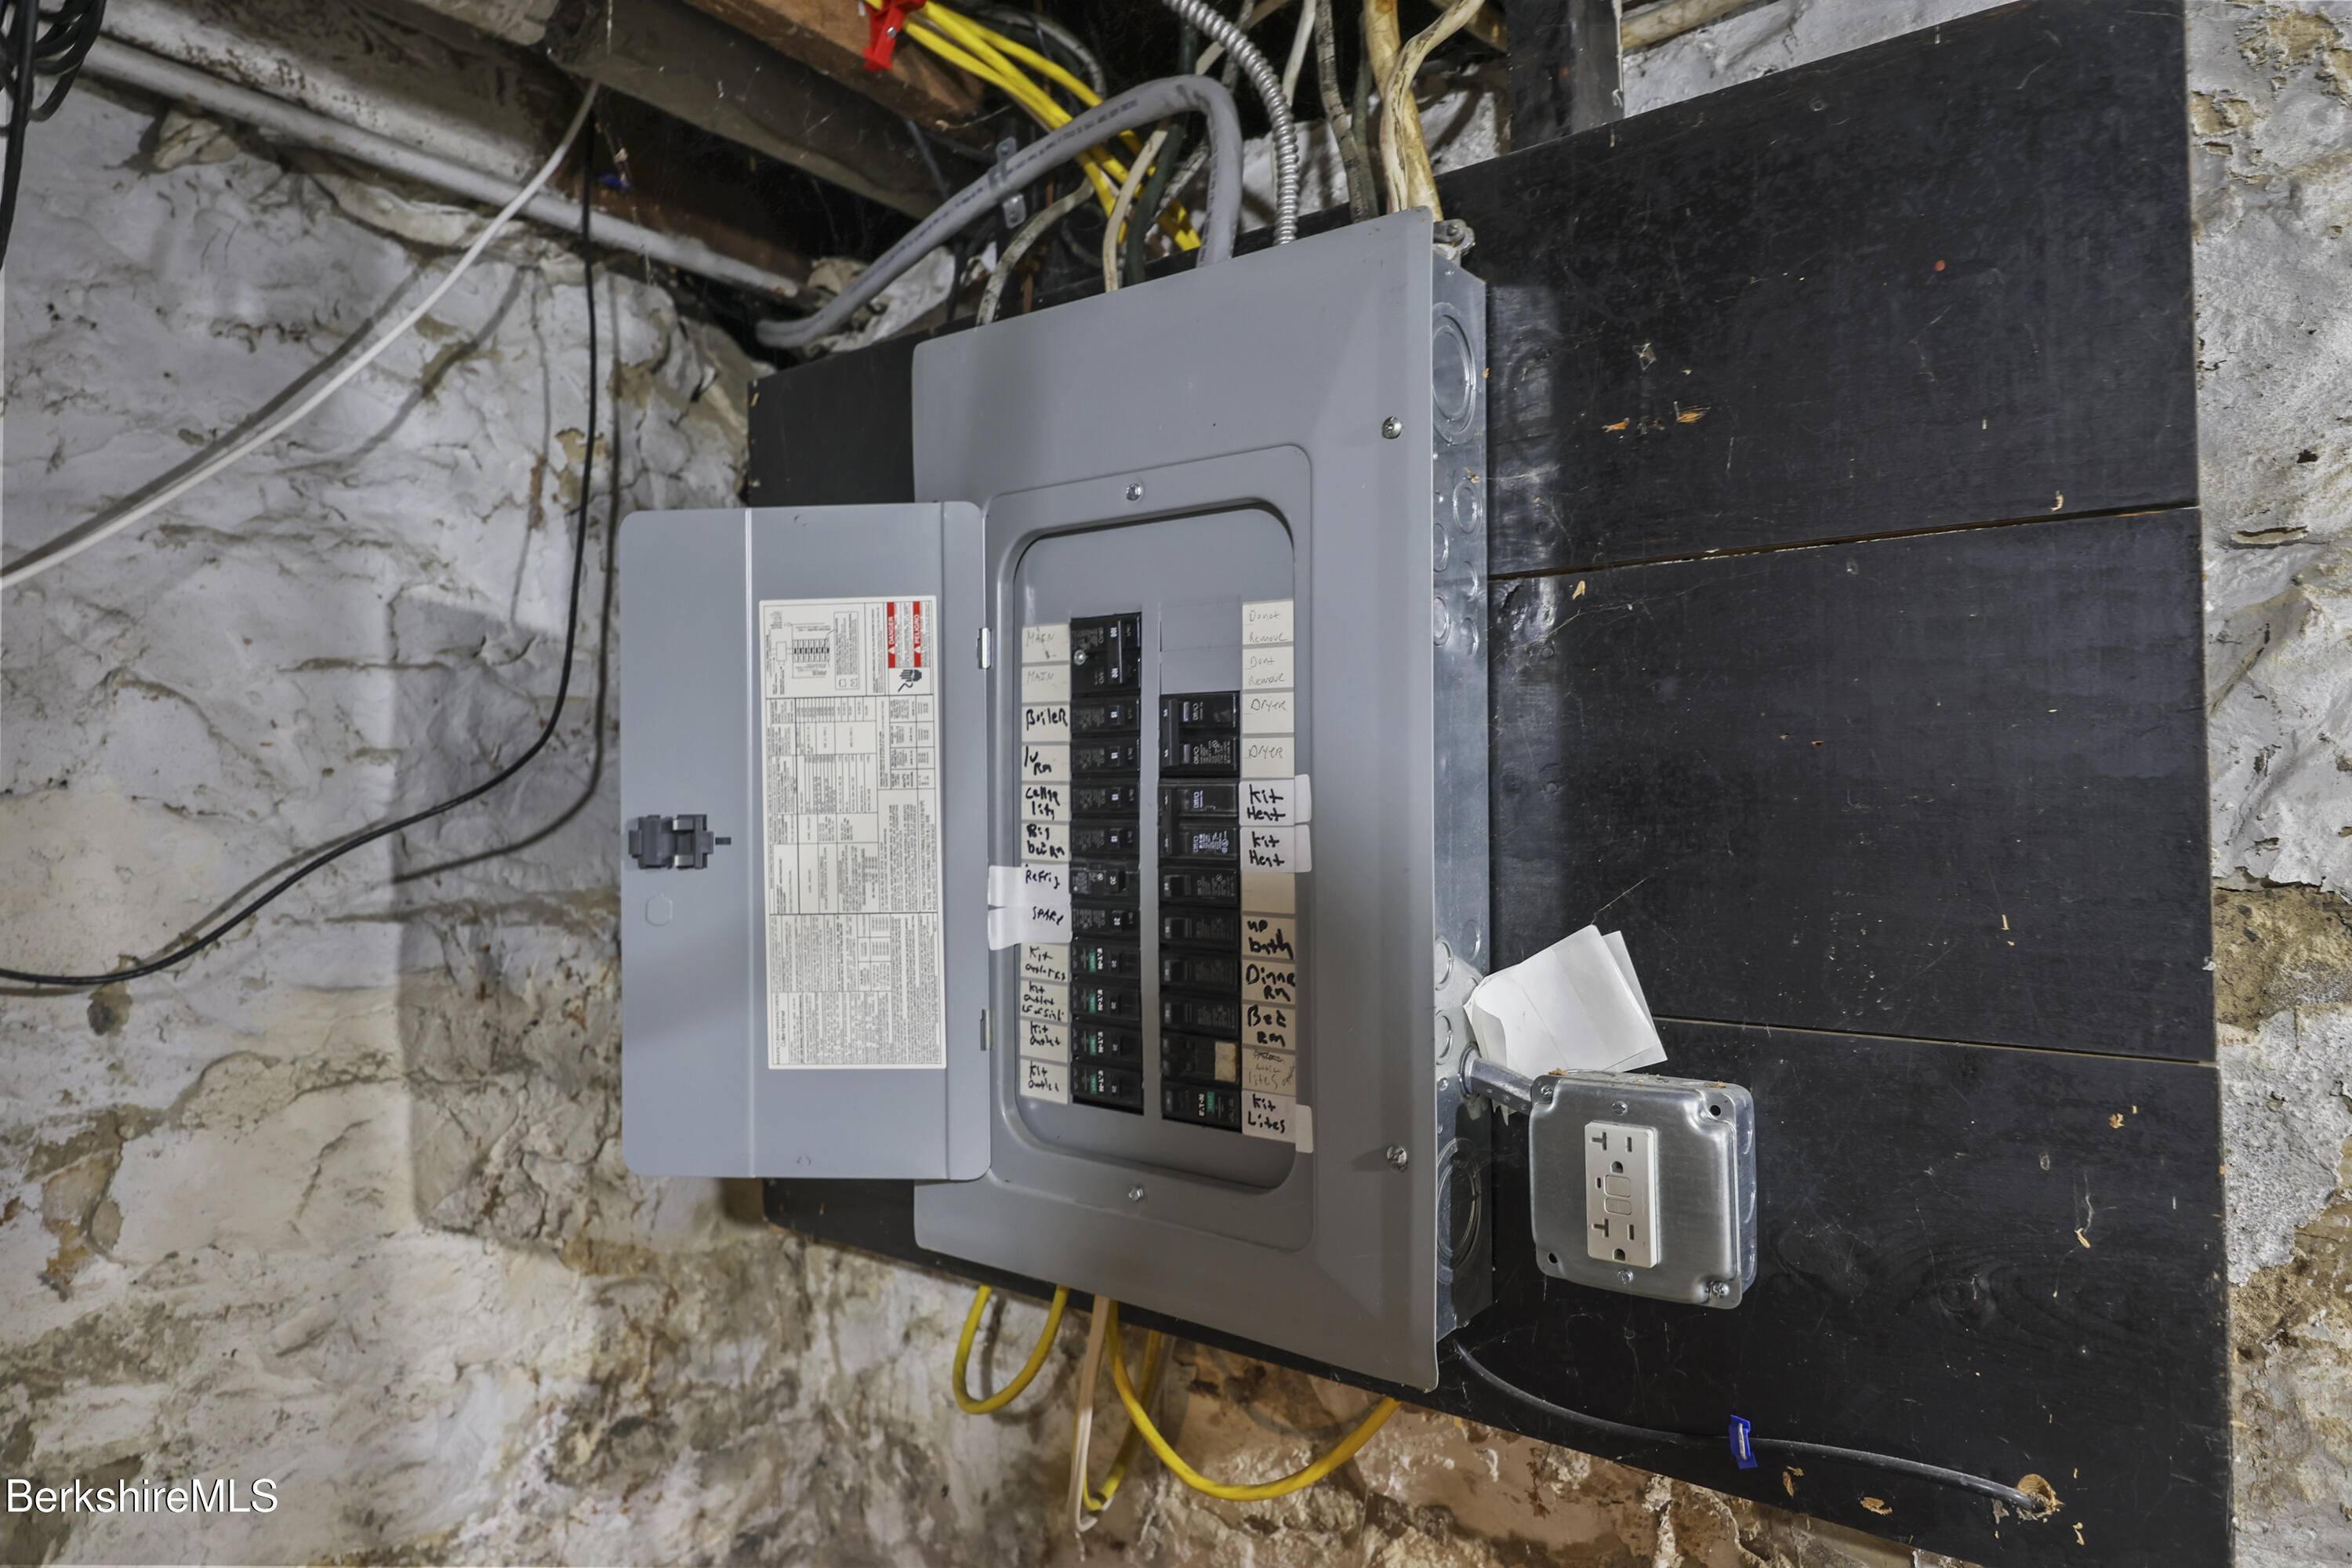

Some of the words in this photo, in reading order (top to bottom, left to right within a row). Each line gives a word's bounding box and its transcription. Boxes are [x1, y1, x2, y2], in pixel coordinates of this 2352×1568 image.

[1027, 670, 1054, 684] MAIN
[1110, 877, 1116, 885] 20
[1248, 1111, 1285, 1134] Lites
